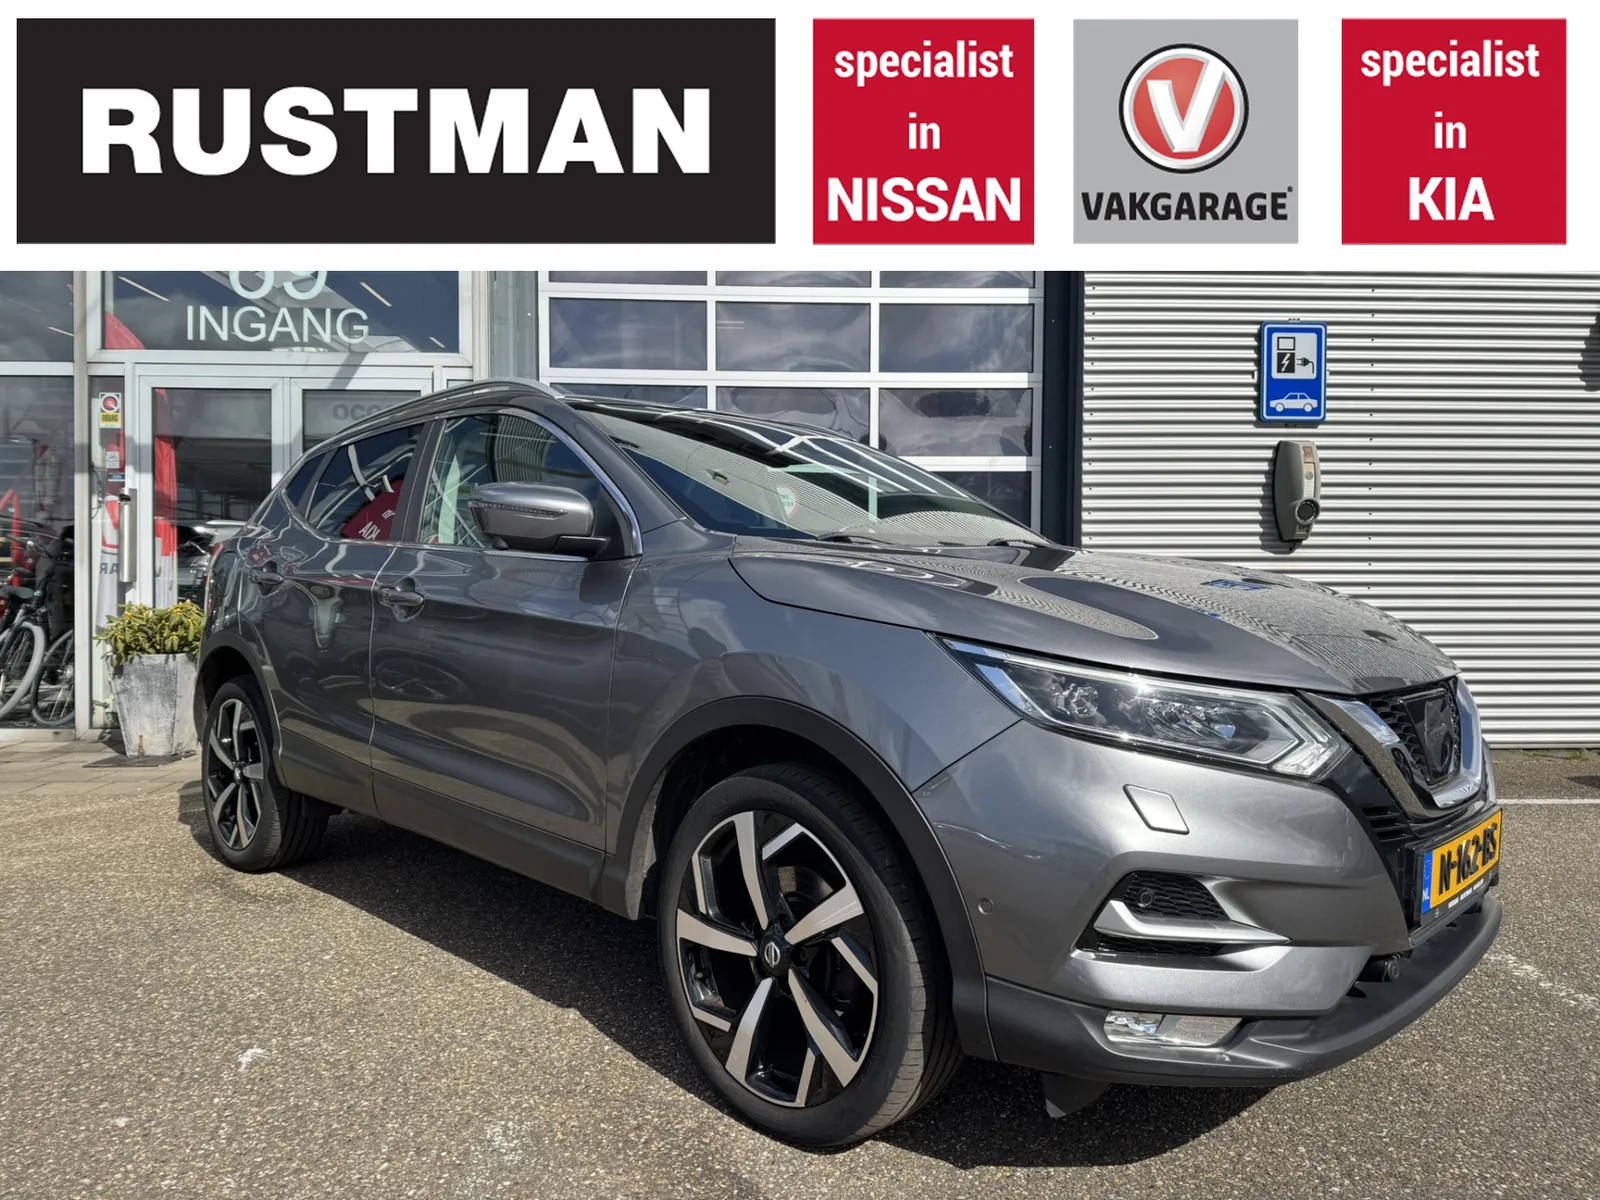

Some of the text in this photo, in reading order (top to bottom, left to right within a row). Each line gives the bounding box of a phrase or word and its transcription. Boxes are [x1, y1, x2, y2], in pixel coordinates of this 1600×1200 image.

[187, 305, 369, 343] INGANG
[1438, 822, 1498, 896] N-162-BS
[1422, 888, 1430, 902] NL
